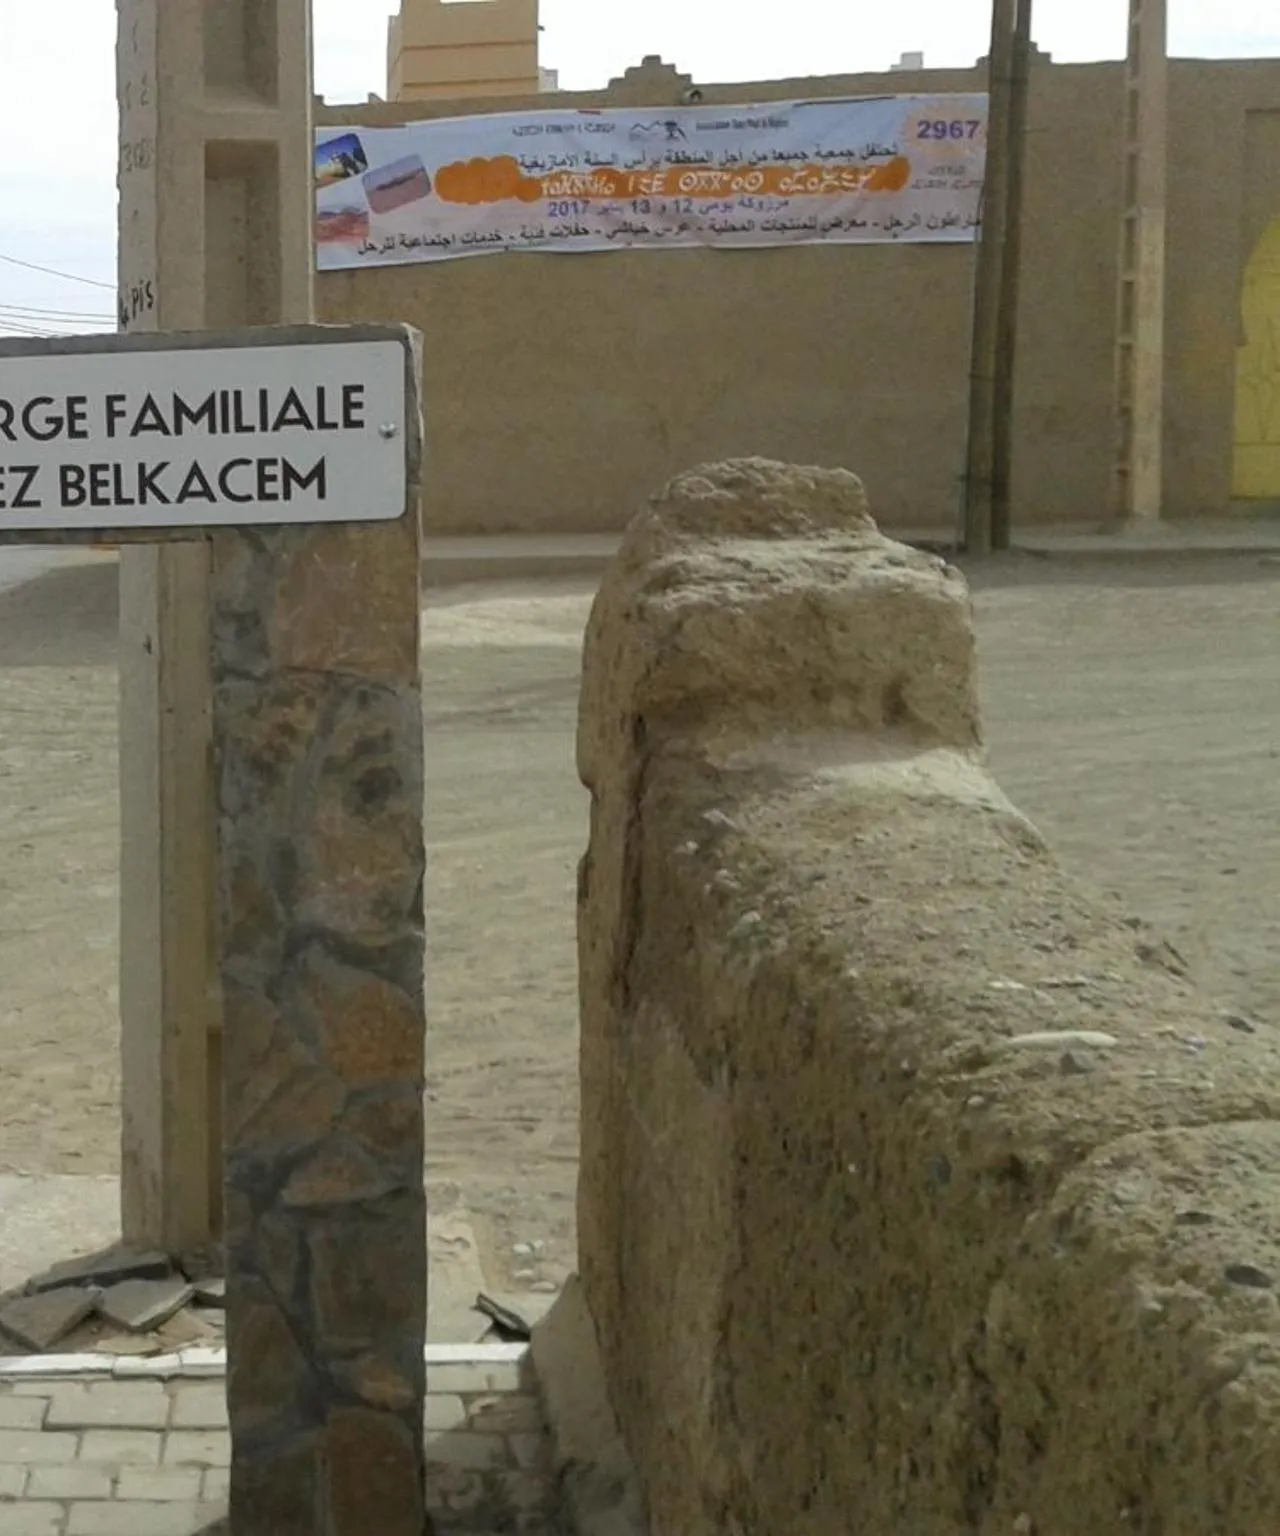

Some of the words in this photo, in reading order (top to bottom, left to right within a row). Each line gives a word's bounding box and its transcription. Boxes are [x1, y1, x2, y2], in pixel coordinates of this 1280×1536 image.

[916, 119, 981, 140] 2967
[813, 142, 854, 162] جمعية
[547, 198, 590, 218] 2017
[631, 198, 651, 215] 13
[674, 197, 692, 213] 12
[104, 384, 365, 438] FAMILIALE
[58, 456, 327, 508] BELKACEM
